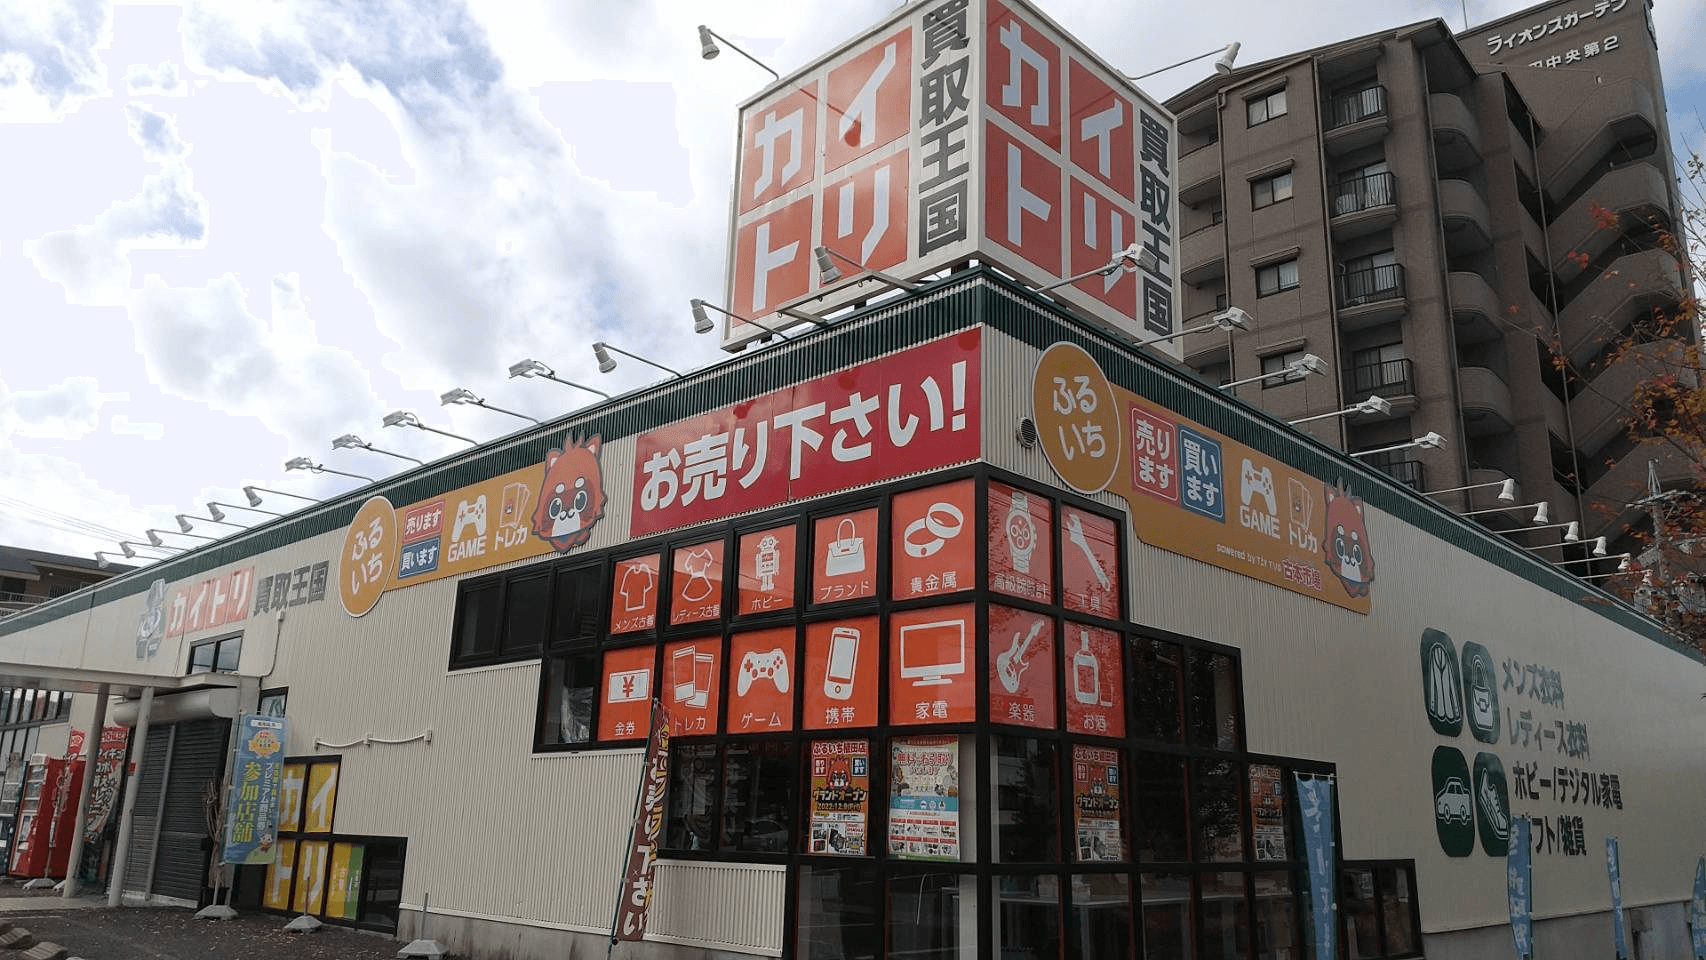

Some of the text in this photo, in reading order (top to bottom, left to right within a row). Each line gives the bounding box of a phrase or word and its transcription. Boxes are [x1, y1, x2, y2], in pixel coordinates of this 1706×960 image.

[918, 0, 970, 257] 買取王国
[1139, 108, 1174, 344] 買取王国
[1053, 375, 1097, 415] ふる
[640, 360, 968, 512] お売り下さい!
[1058, 420, 1106, 461] いち
[1135, 418, 1170, 460] 売り
[1183, 437, 1218, 476] 買い
[1138, 456, 1174, 489] ます
[1186, 475, 1219, 507] ます
[404, 509, 442, 536] 売ります
[1239, 504, 1281, 540] GAME
[351, 516, 384, 561] ふる
[447, 535, 487, 563] GAME
[494, 526, 529, 551] トレカ
[1288, 523, 1318, 554] トレカ
[400, 545, 437, 571] 買います
[351, 551, 383, 596] いち
[910, 571, 957, 594] 貴金属
[169, 570, 251, 633] カイトリ
[253, 560, 330, 618] 買取王国
[751, 596, 783, 610] ホビー
[820, 580, 870, 601] ブランド
[614, 614, 656, 632] メンズ古着
[672, 604, 721, 622] レディース古着
[622, 675, 636, 698] ¥
[674, 716, 706, 733] トレカ
[741, 712, 782, 730] ゲーム
[825, 706, 855, 725] 携帯
[915, 700, 948, 720] 家電
[1008, 702, 1036, 722] 楽器
[1083, 714, 1107, 732] お酒
[614, 720, 636, 736] 金券
[232, 761, 263, 844] 参加店舗
[1531, 814, 1587, 856] フト/雑貨
